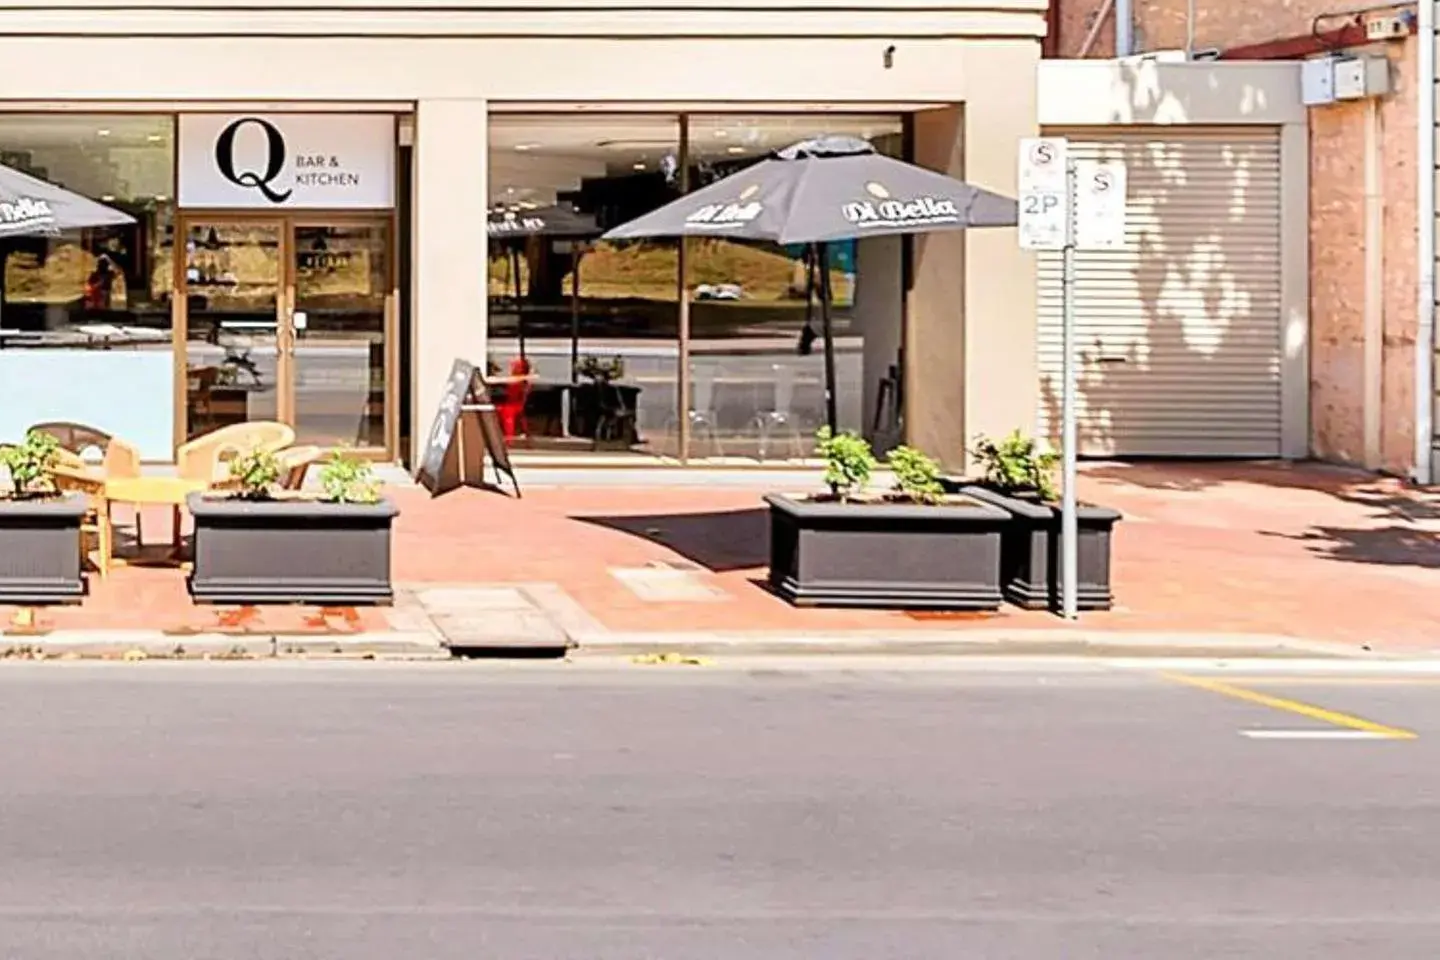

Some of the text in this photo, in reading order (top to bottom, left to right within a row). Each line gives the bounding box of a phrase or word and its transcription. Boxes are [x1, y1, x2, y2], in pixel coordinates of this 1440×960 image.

[215, 117, 293, 203] Q
[295, 155, 340, 168] BAR &
[295, 173, 360, 186] KITCHEN
[879, 196, 960, 221] Bella
[1023, 194, 1059, 215] 2P
